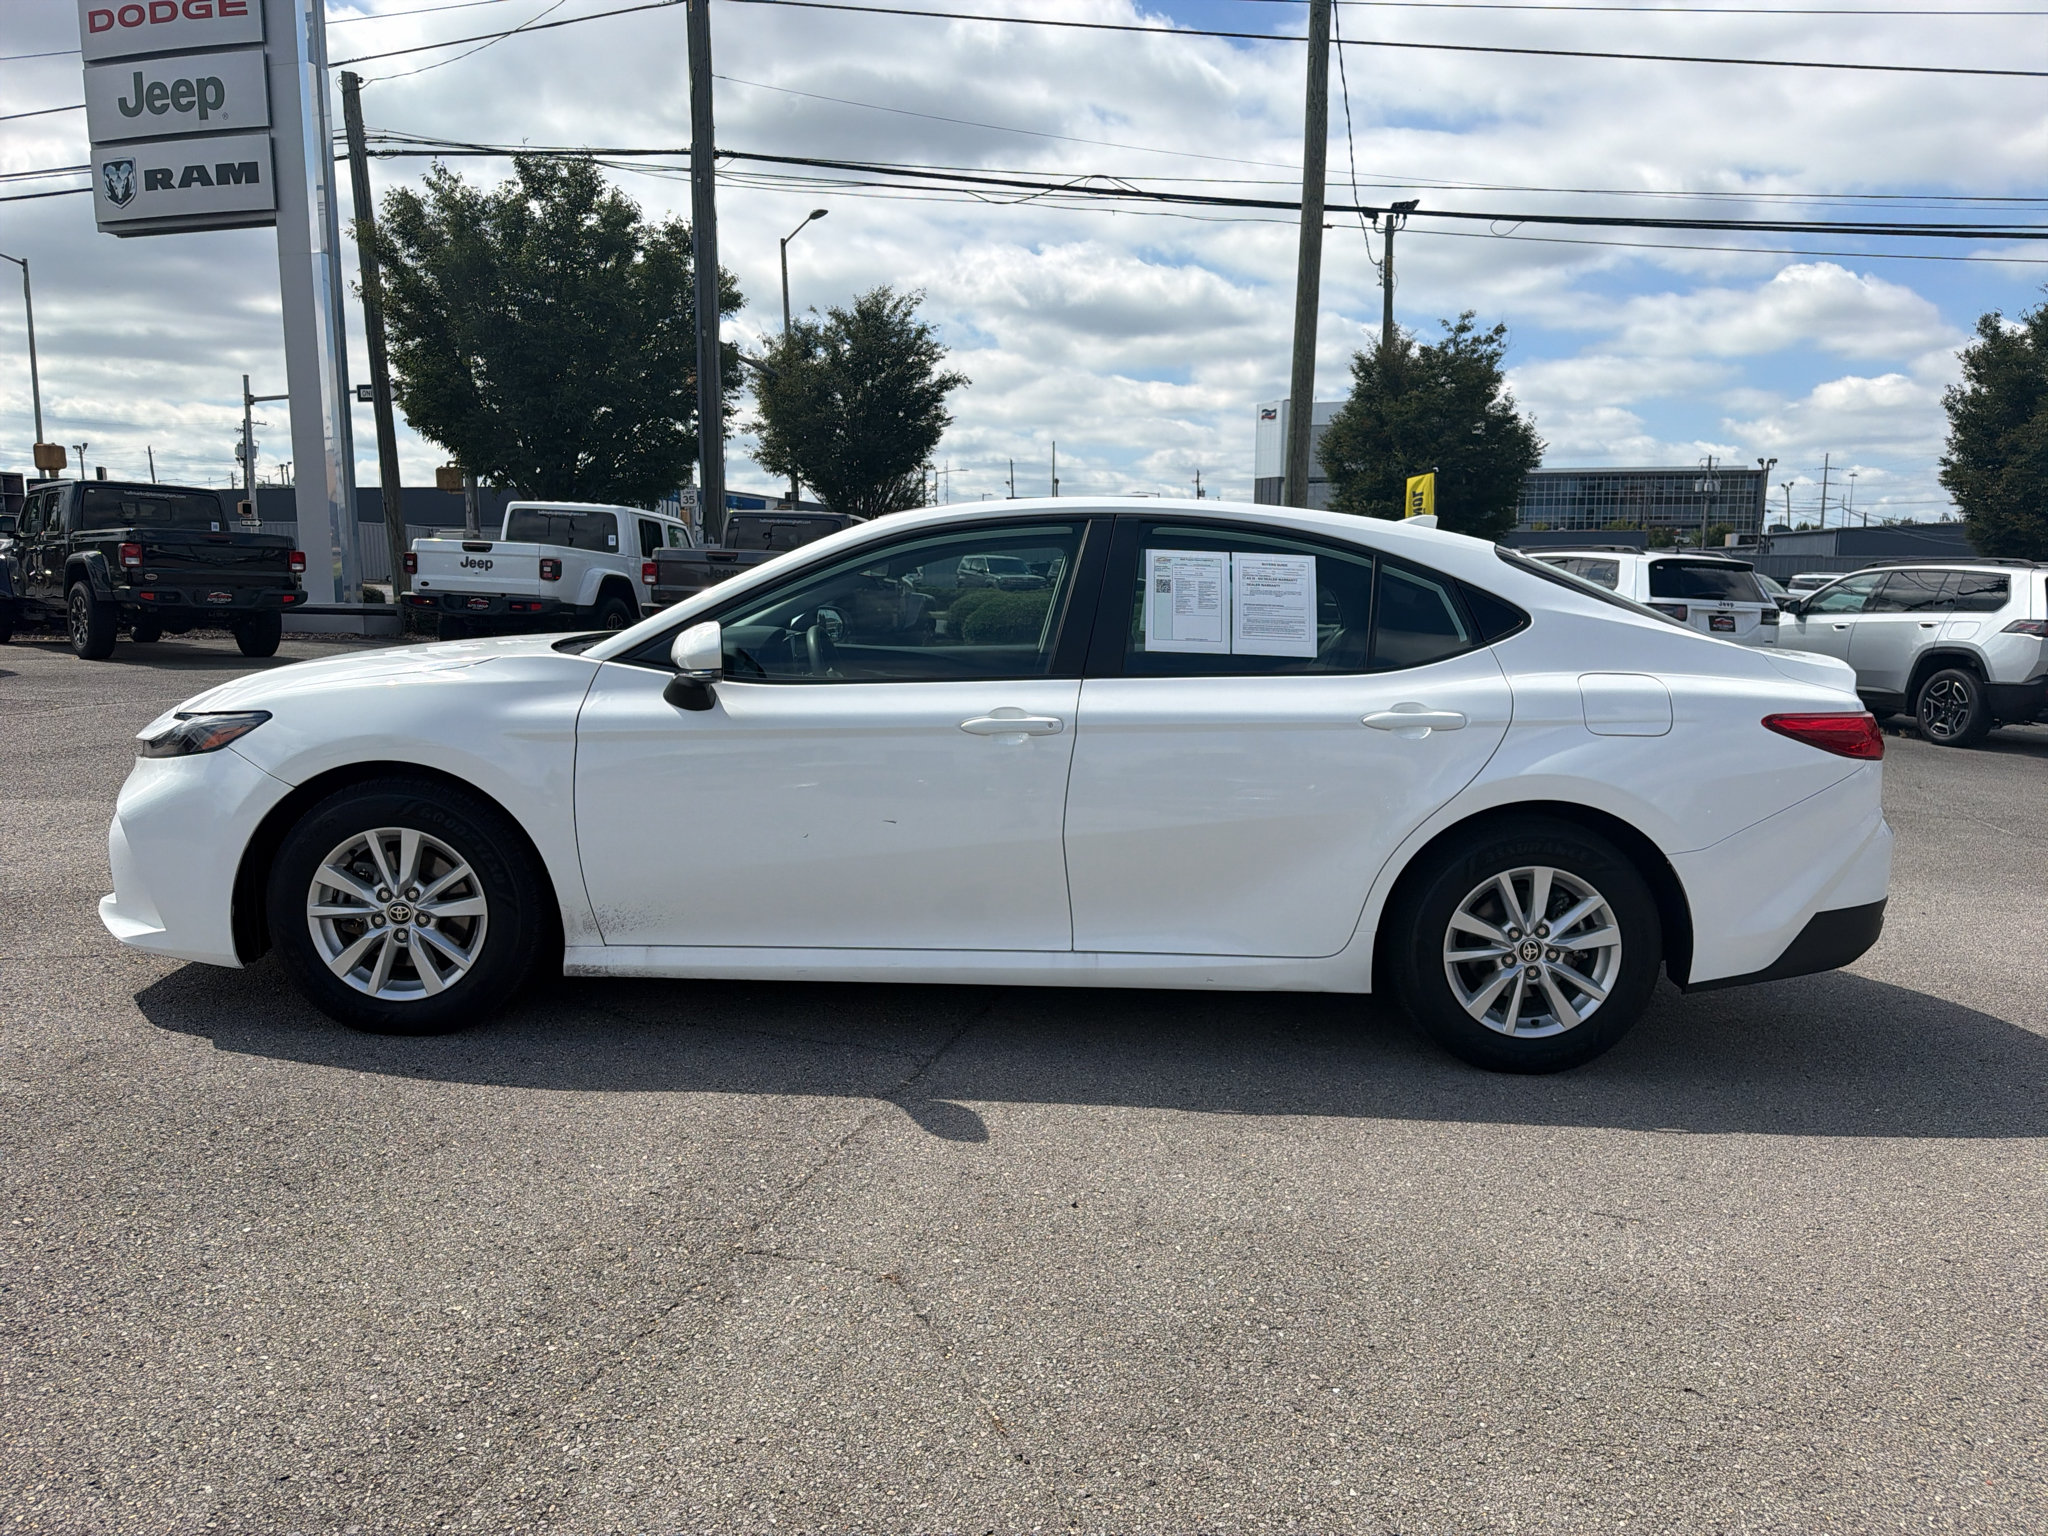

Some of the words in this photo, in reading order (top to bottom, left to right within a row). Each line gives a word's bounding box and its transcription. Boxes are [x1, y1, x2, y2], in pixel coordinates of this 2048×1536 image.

[88, 0, 248, 33] DODGE
[117, 71, 225, 120] Jeep
[144, 161, 260, 191] RAM
[682, 495, 695, 505] 35
[460, 556, 493, 571] Jeep
